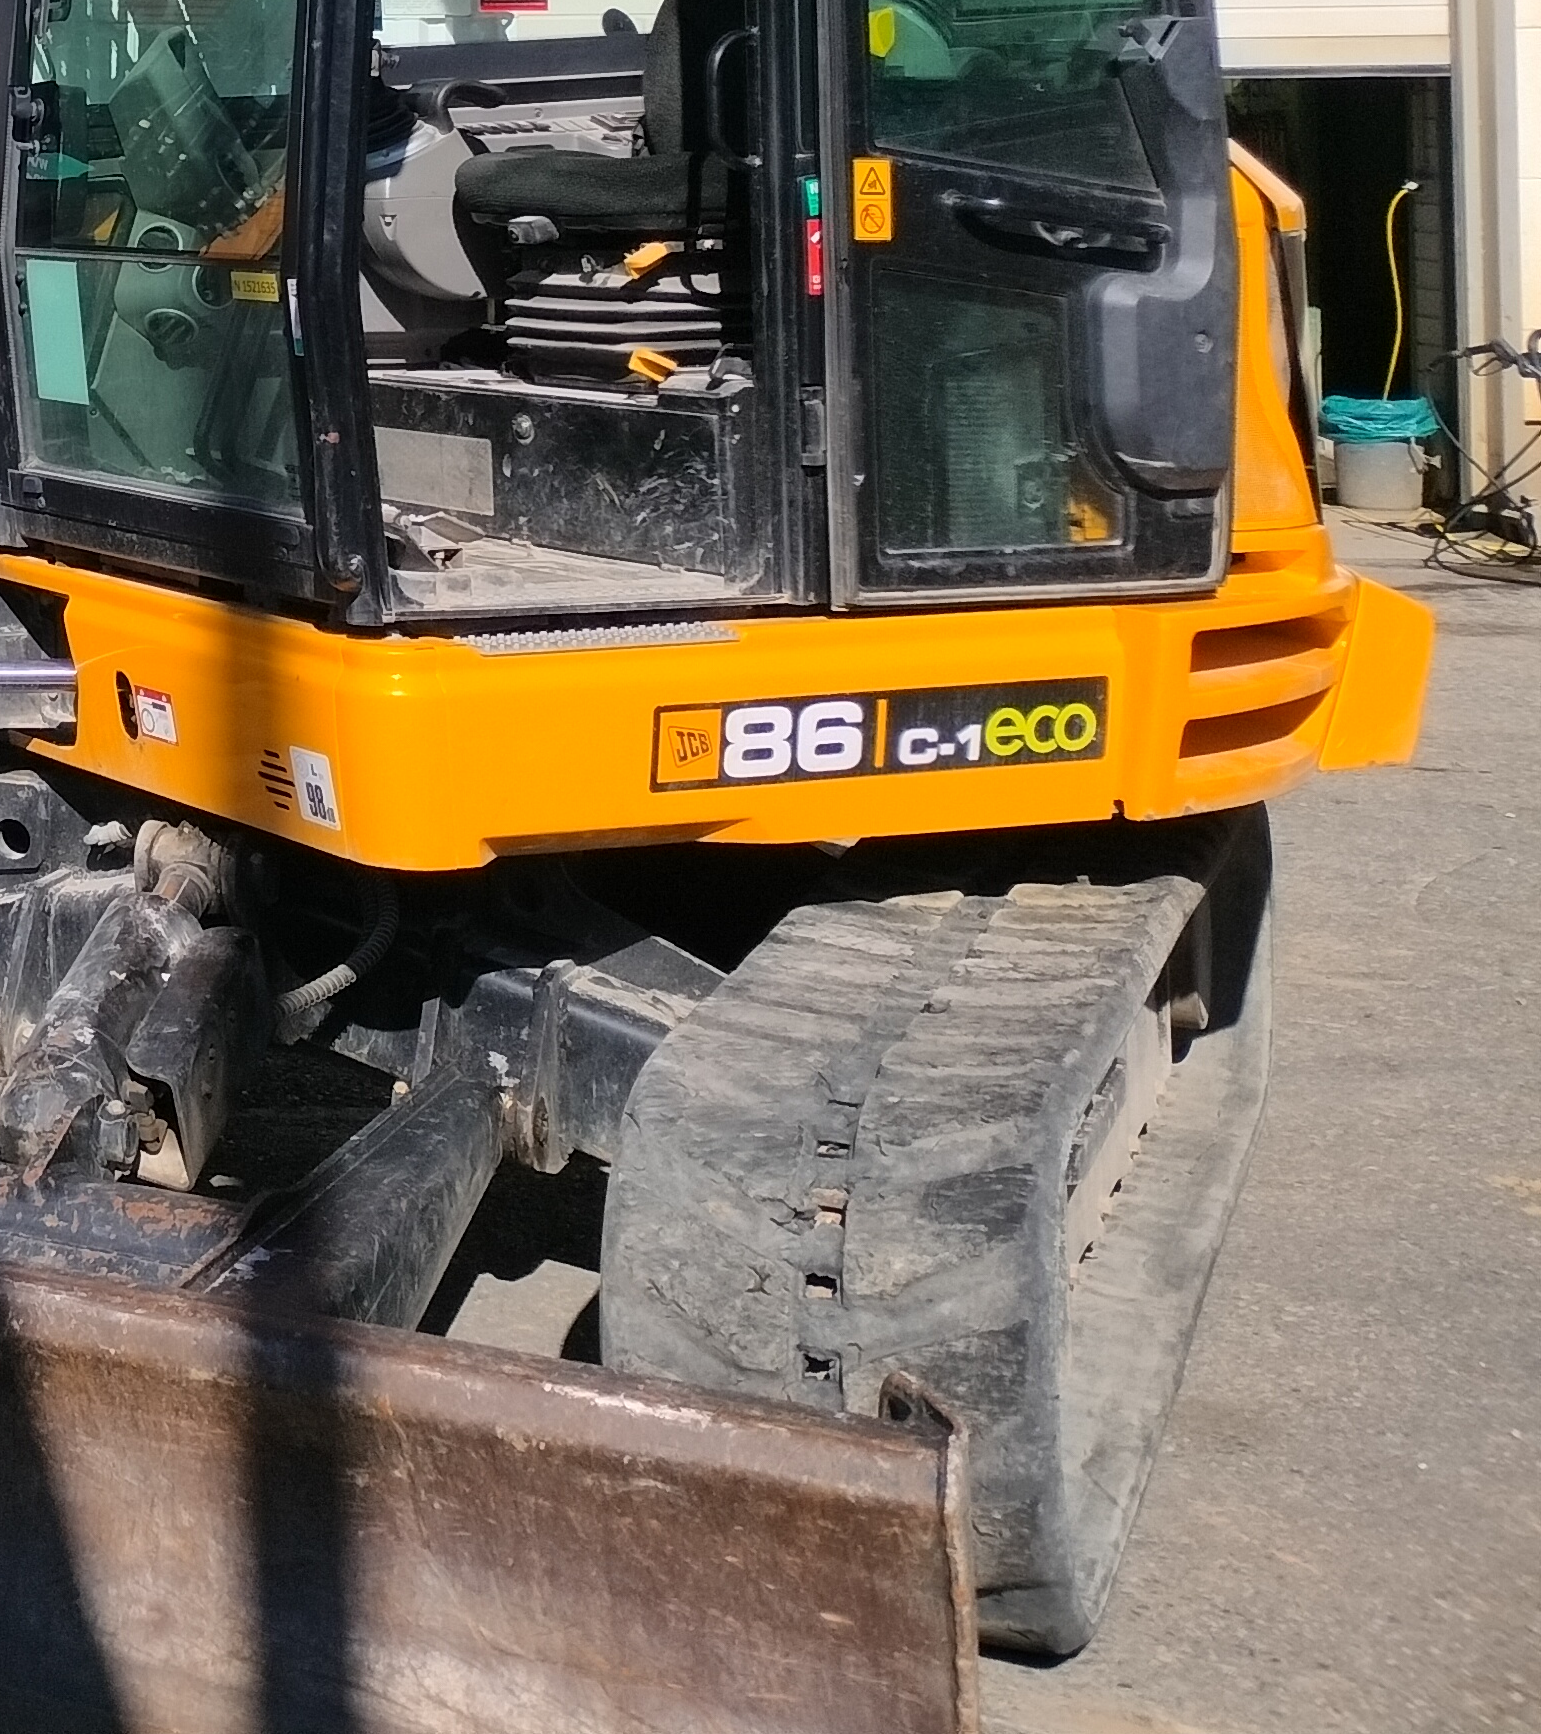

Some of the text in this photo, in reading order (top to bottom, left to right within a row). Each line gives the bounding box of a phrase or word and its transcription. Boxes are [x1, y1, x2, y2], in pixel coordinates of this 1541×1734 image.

[675, 730, 710, 763] JCB
[723, 700, 864, 779] 86
[985, 702, 1097, 757] eco
